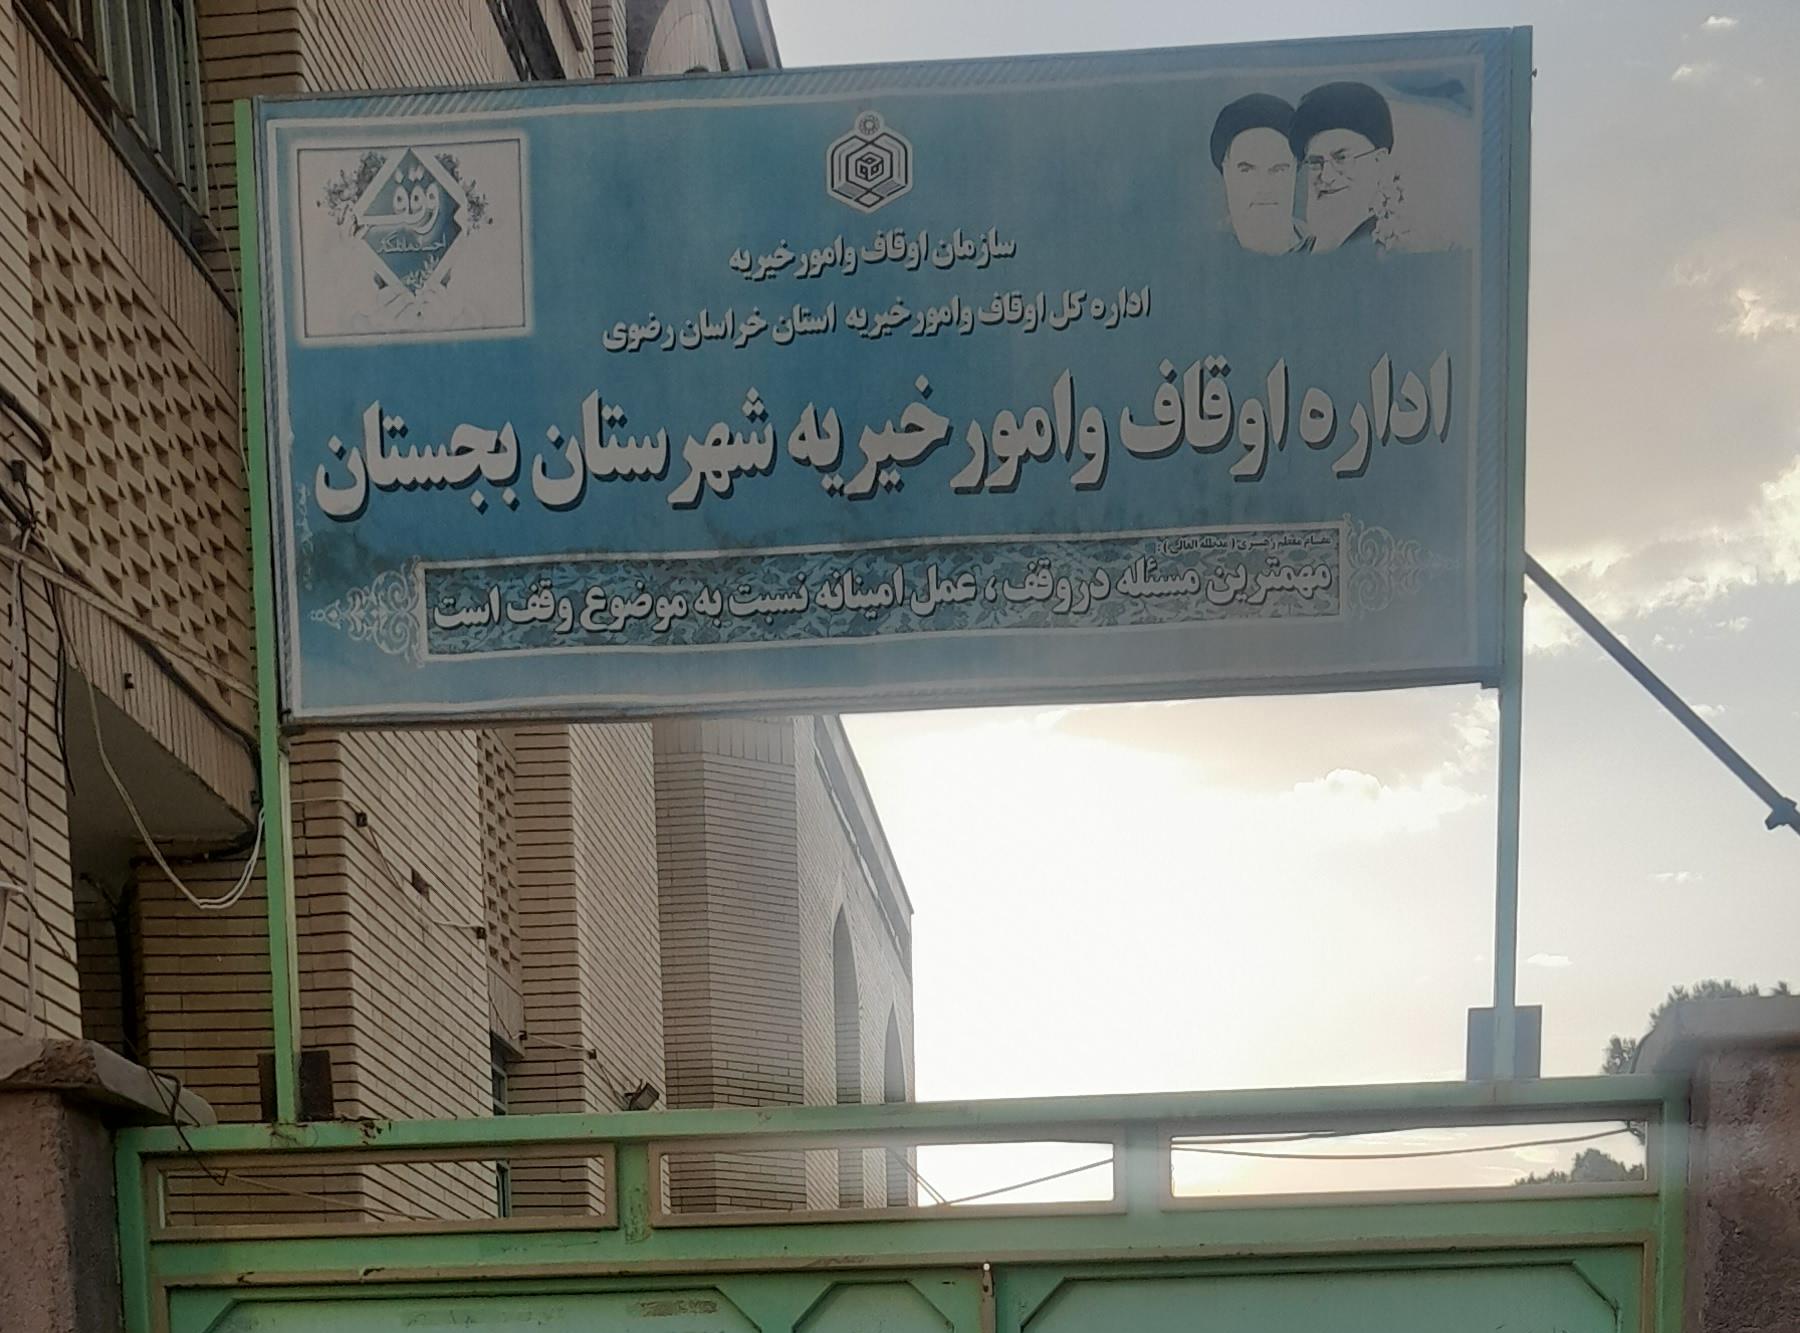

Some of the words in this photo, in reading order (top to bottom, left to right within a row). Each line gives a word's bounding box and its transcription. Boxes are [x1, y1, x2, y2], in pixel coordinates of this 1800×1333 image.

[728, 239, 795, 281] خیریه
[861, 229, 928, 270] اوقاف
[932, 226, 1016, 269] سازمان
[678, 306, 769, 350] خراسان
[772, 301, 837, 344] استان
[845, 296, 911, 339] خیریه
[978, 290, 1046, 332] اوقاف
[1051, 289, 1088, 331] کل
[1090, 286, 1151, 329] اداره
[602, 311, 677, 352] رضوی
[1120, 353, 1289, 483] اوقاف
[1300, 349, 1452, 480] اداره
[532, 386, 776, 510] شهرستان
[786, 374, 953, 502] خیریه
[314, 399, 521, 523] بجستان
[727, 572, 810, 626] نسبت
[814, 563, 905, 621] امینانه
[909, 562, 978, 617] عمل
[1115, 555, 1202, 598] مسئله
[1205, 556, 1333, 606] مهمترین
[432, 584, 500, 630] است
[505, 578, 575, 635] وقف
[579, 580, 689, 632] موضوع
[693, 585, 724, 627] به
